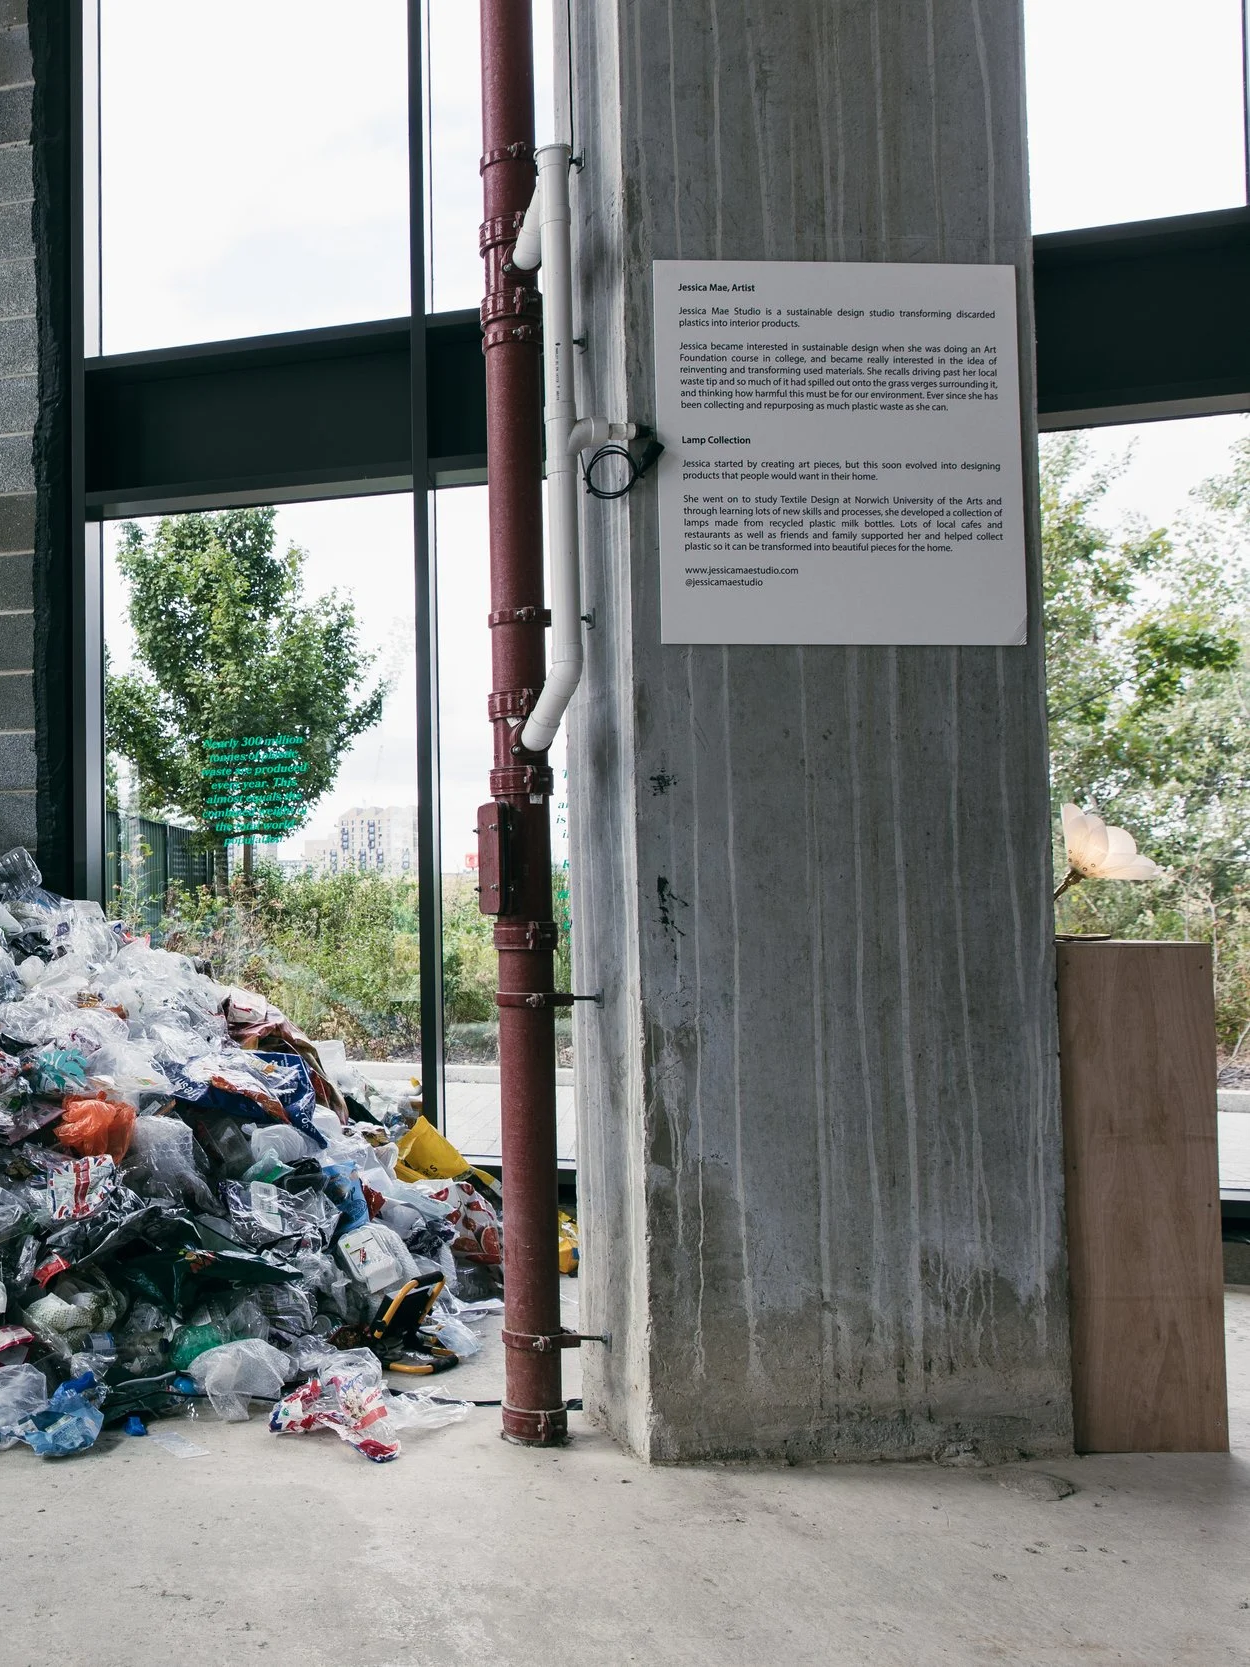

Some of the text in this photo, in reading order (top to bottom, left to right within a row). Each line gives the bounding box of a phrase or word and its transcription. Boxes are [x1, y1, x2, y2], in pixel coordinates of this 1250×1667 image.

[677, 282, 755, 292] Jessica Mae, Artist
[678, 306, 706, 315] Jessica
[711, 306, 729, 315] Mae
[733, 306, 761, 315] Studio
[765, 307, 772, 315] is
[786, 307, 833, 316] sustainable
[836, 308, 864, 318] design
[869, 308, 895, 317] studio
[899, 308, 952, 320] transforming
[955, 309, 995, 319] discarded
[678, 318, 800, 329] plastics into interior products.
[678, 342, 707, 350] Jessica
[710, 341, 743, 351] became
[746, 341, 788, 351] interested
[790, 342, 799, 350] in
[801, 342, 848, 351] sustainable
[850, 343, 879, 354] design
[881, 343, 905, 352] when
[907, 343, 922, 352] she
[943, 344, 968, 355] doing
[983, 345, 996, 353] Art
[679, 353, 727, 362] Foundation
[762, 354, 771, 362] in
[774, 354, 806, 364] college,
[810, 354, 826, 363] and
[830, 354, 863, 363] became
[866, 355, 889, 365] really
[892, 355, 934, 364] interested
[937, 356, 945, 364] in
[949, 356, 963, 364] the
[966, 356, 984, 365] idea
[988, 356, 998, 365] of
[680, 400, 702, 409] been
[703, 400, 744, 411] collecting
[745, 400, 762, 409] and
[763, 401, 814, 411] repurposing
[826, 401, 850, 410] much
[851, 401, 878, 412] plastic
[915, 402, 930, 411] she
[681, 435, 751, 446] Lamp Collection
[681, 459, 710, 468] Jessica
[713, 459, 743, 468] started
[746, 459, 758, 469] by
[760, 459, 795, 470] creating
[797, 460, 810, 468] art
[813, 460, 842, 470] pieces,
[844, 460, 859, 468] but
[862, 460, 878, 469] this
[905, 460, 937, 469] evolved
[940, 461, 957, 469] into
[960, 461, 1001, 472] designing
[682, 470, 878, 481] products that people would want in their home.
[683, 494, 699, 503] She
[702, 495, 723, 503] went
[741, 495, 751, 503] to
[754, 495, 777, 505] study
[779, 495, 807, 503] Textile
[810, 495, 839, 505] Design
[842, 496, 851, 504] at
[854, 495, 889, 504] Norwich
[892, 496, 934, 506] University
[936, 496, 946, 504] of
[948, 496, 963, 505] the
[965, 496, 983, 505] Arts
[985, 497, 1002, 505] and
[683, 518, 1003, 529] lamps made from recycled plastic milk bottles. Lots of local cafes and
[684, 565, 798, 576] www.jessicamaestudio.com
[684, 577, 763, 588] @jessicamaestudio
[202, 735, 304, 749] Nearly 300 million
[210, 749, 299, 763] tonnes of plastic
[201, 762, 310, 776] waste are produced
[211, 777, 298, 791] every year. This
[206, 791, 302, 804] almost equals the
[215, 819, 295, 832] the total world
